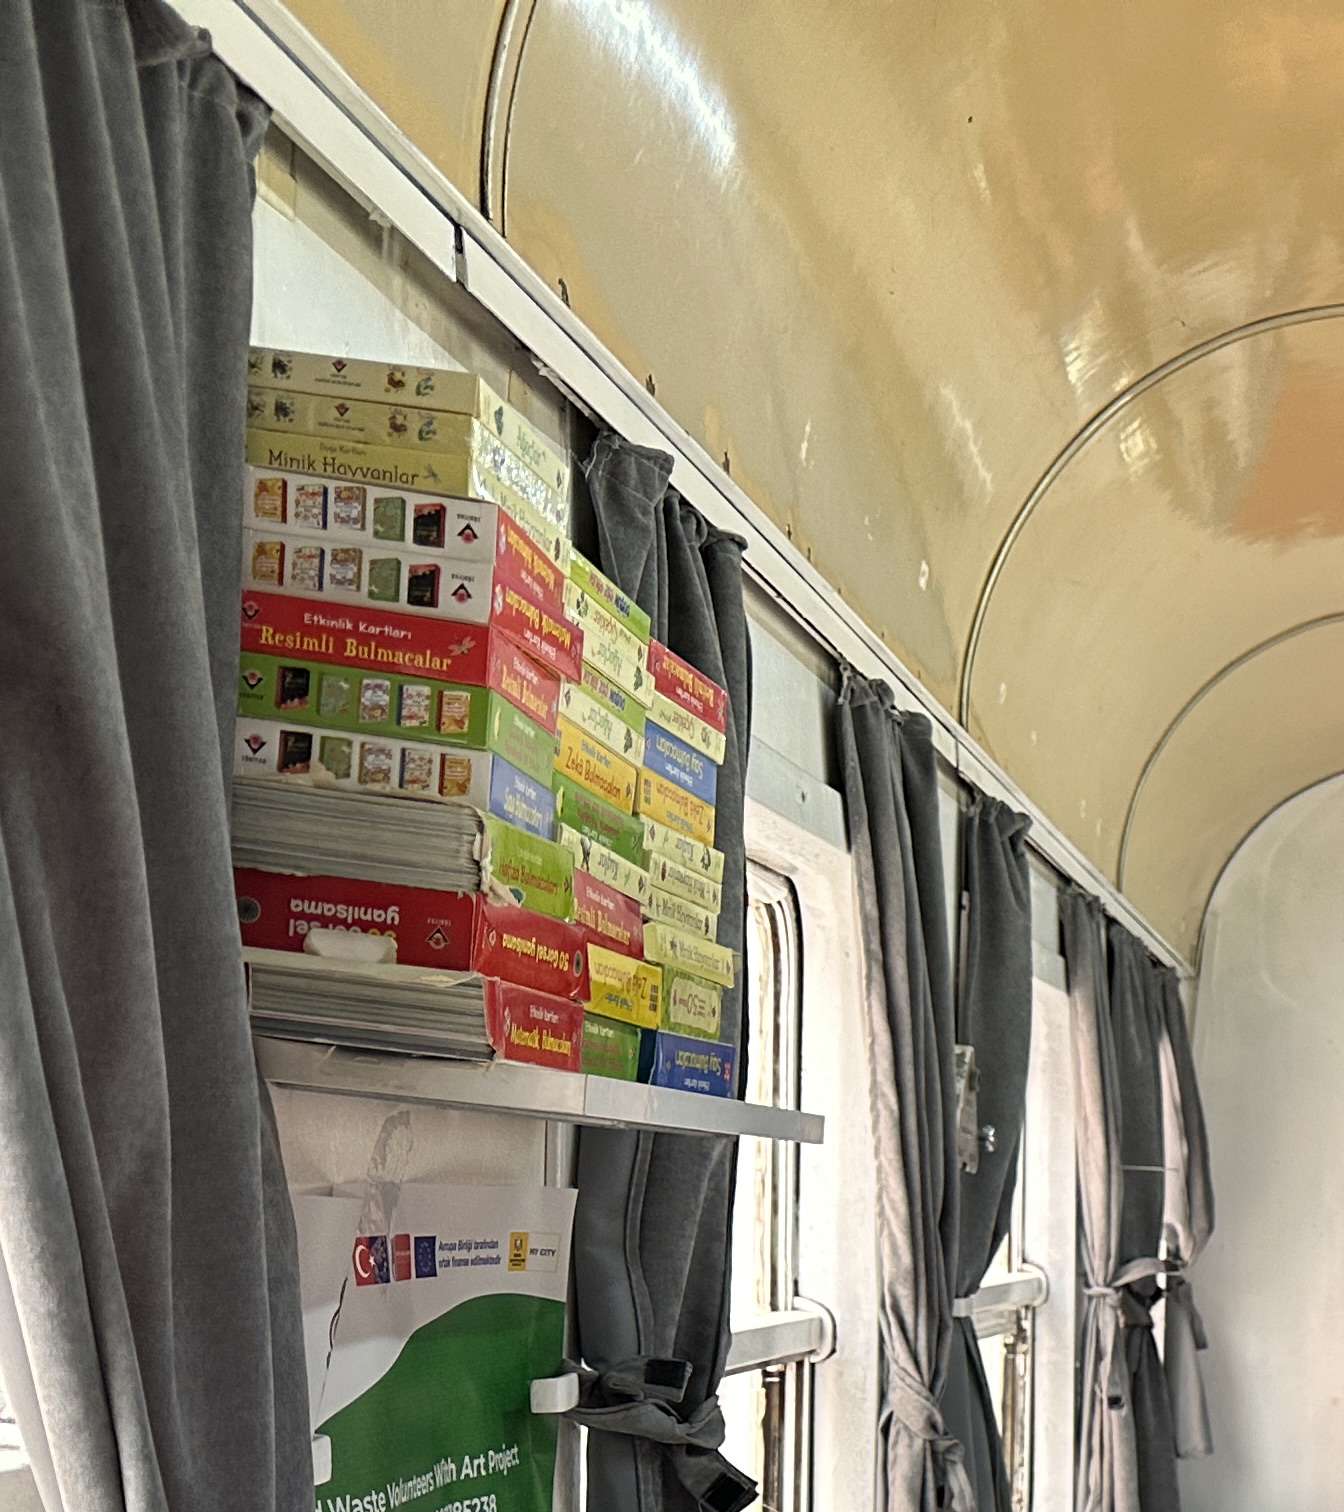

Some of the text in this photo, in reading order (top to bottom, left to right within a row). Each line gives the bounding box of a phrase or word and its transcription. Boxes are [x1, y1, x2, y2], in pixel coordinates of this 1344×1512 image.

[268, 449, 317, 471] Minik
[304, 612, 412, 640] Etkinlik Kartları
[259, 625, 452, 672] Resimli Bulmacalar
[290, 899, 400, 926] yanılsama
[387, 1470, 434, 1510] Volunteers
[460, 1453, 487, 1480] Art
[488, 1443, 520, 1476] Project
